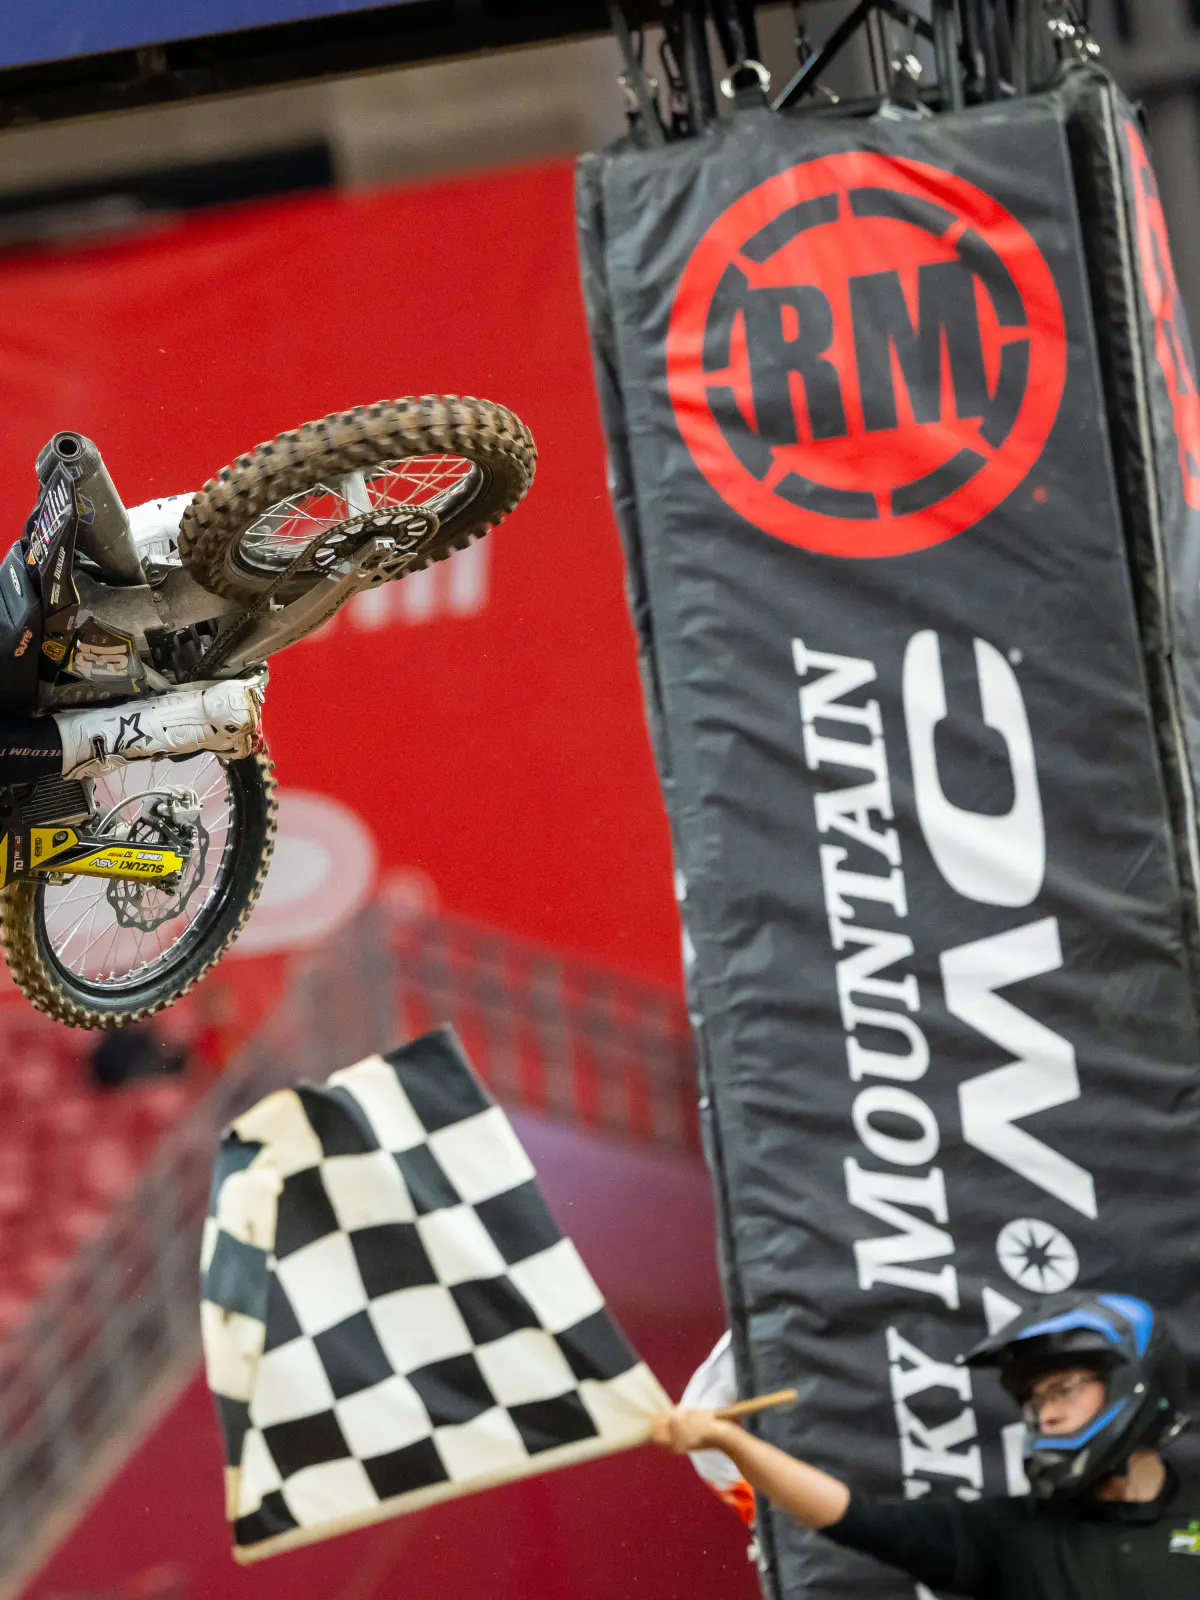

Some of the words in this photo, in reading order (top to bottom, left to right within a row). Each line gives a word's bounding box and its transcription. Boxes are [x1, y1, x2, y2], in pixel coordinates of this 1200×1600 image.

[744, 258, 992, 447] RM
[53, 546, 67, 581] DUNLOP
[13, 628, 33, 657] GUTS
[88, 857, 119, 869] ASV
[118, 861, 165, 873] SUZUKI
[792, 637, 960, 1311] MOUNTAIN
